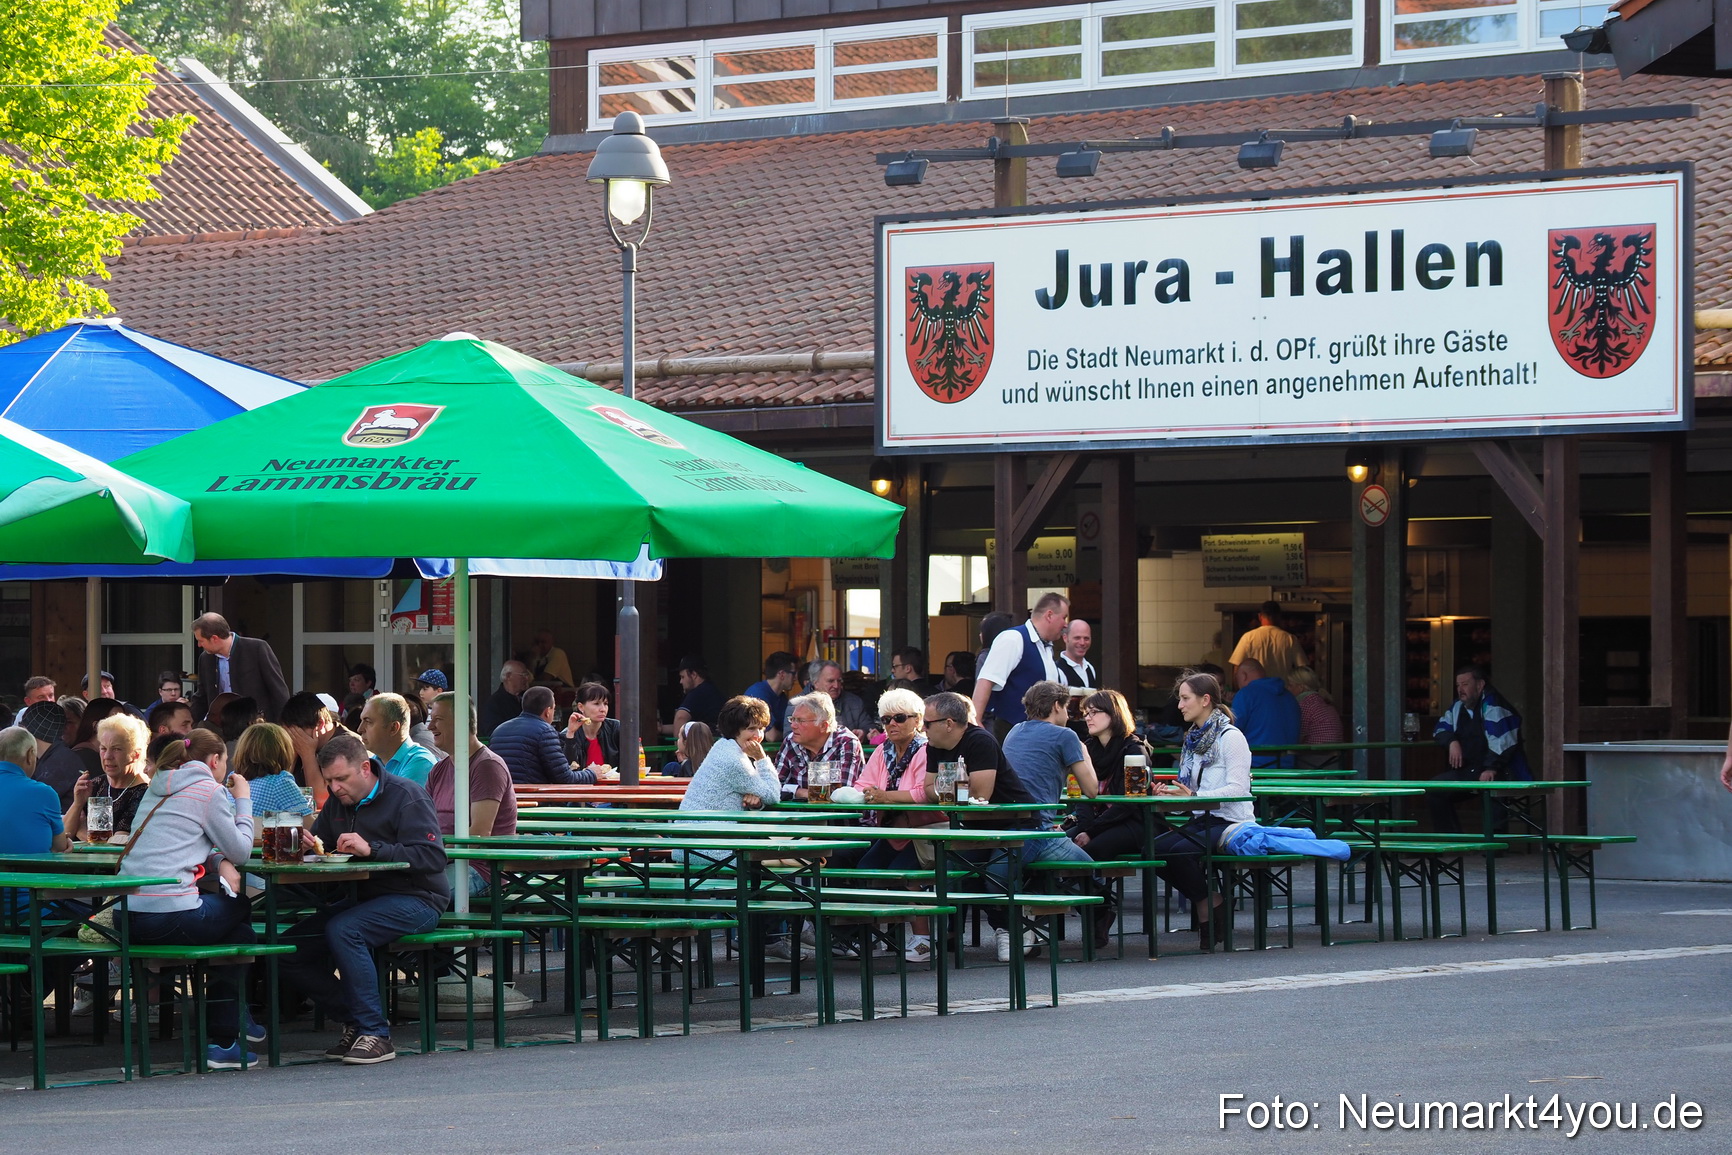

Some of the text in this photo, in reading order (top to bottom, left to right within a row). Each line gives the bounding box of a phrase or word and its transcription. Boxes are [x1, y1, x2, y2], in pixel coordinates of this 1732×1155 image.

[1035, 249, 1191, 311] Jura
[1260, 229, 1503, 299] Hallen
[1027, 329, 1508, 371] Die Stadt Neumarkt i. d. OPf. grüßt ihre Gäste
[1002, 361, 1538, 405] und wünscht Ihnen einen angenehmen Aufenthalt!
[359, 436, 394, 444] 1628
[260, 455, 460, 472] Neumarkter
[205, 471, 478, 493] Lammsbräu
[1055, 549, 1073, 559] 9,00
[1057, 573, 1075, 584] 1,70
